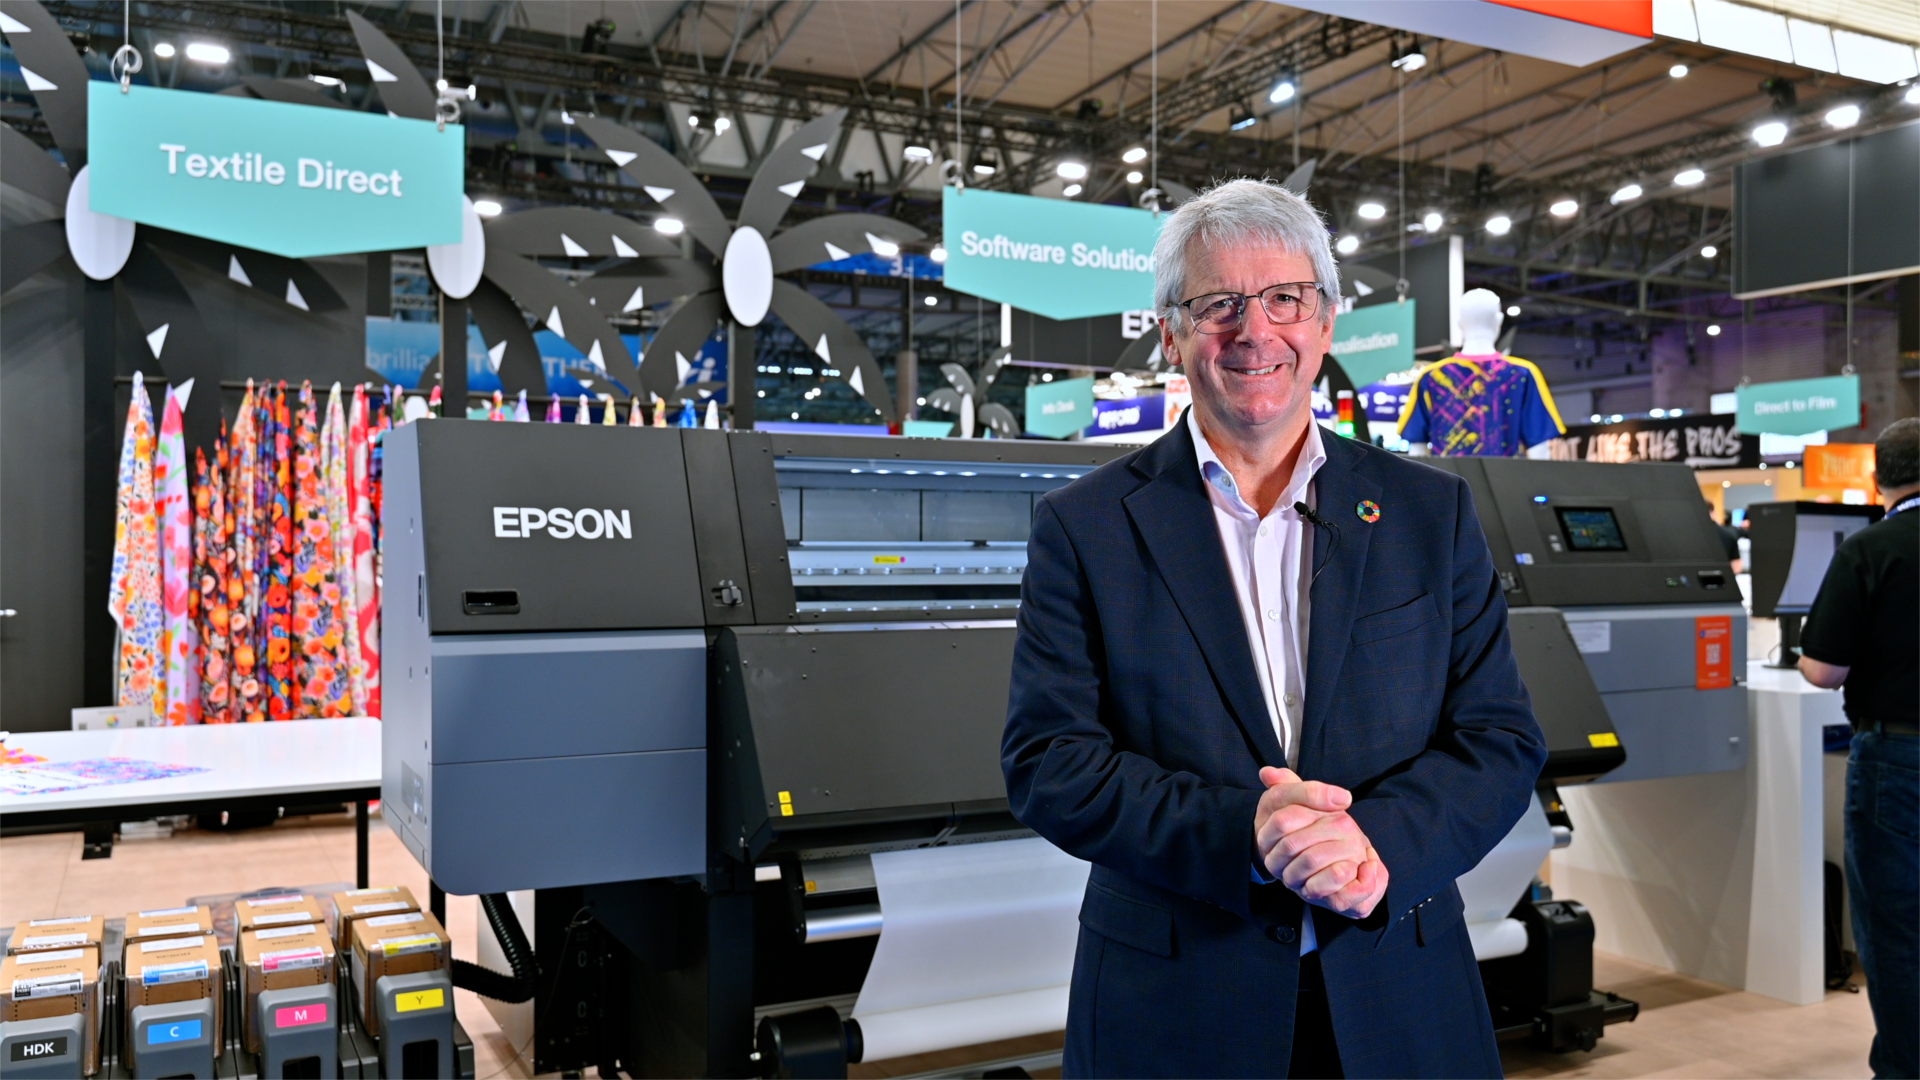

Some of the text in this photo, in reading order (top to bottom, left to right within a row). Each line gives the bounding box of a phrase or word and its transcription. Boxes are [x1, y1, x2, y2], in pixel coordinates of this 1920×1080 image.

[159, 143, 403, 197] Textile Direct
[961, 230, 1066, 265] Software
[1754, 395, 1838, 416] Direct to Film
[1586, 431, 1632, 463] LIKE
[1635, 428, 1680, 460] THE
[1684, 424, 1742, 456] PROS
[493, 507, 632, 539] EPSON
[415, 995, 424, 1005] Y
[294, 1009, 308, 1021] M
[170, 1026, 179, 1038] C
[23, 1042, 55, 1057] HDK
